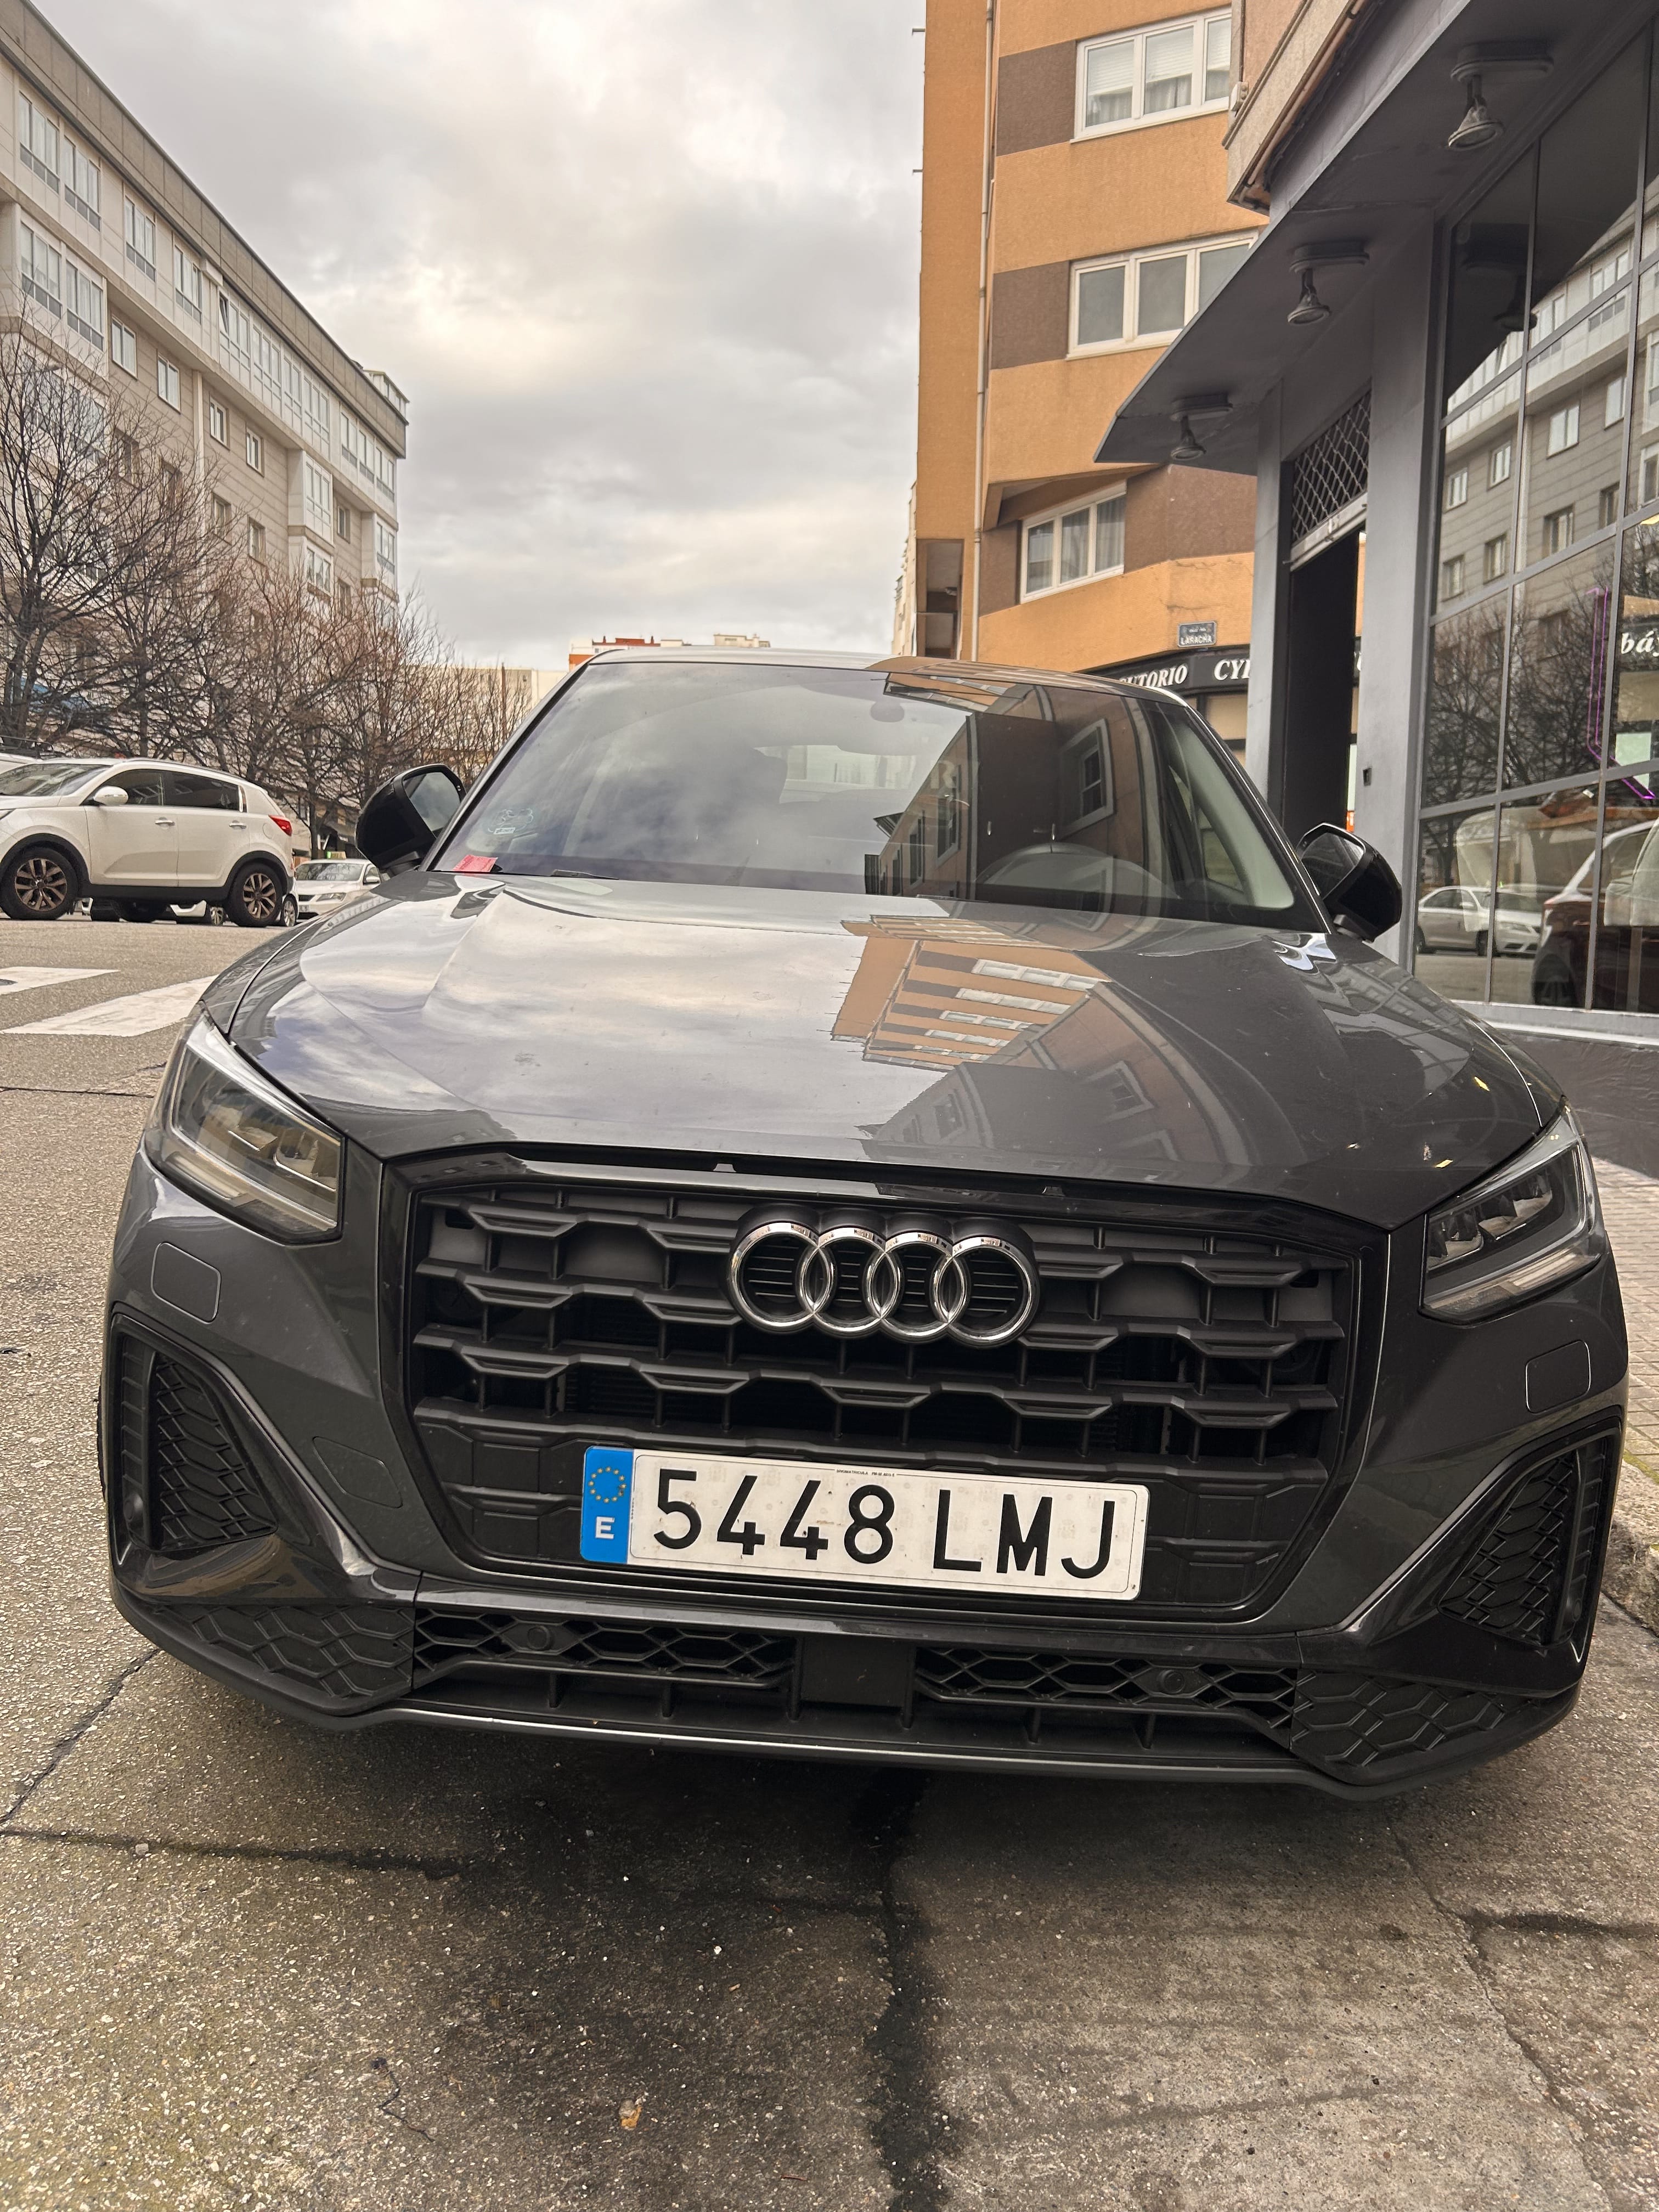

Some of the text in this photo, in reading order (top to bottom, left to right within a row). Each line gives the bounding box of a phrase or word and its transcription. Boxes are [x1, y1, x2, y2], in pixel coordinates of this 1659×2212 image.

[595, 1468, 1115, 1579] E 5448 LMJ
